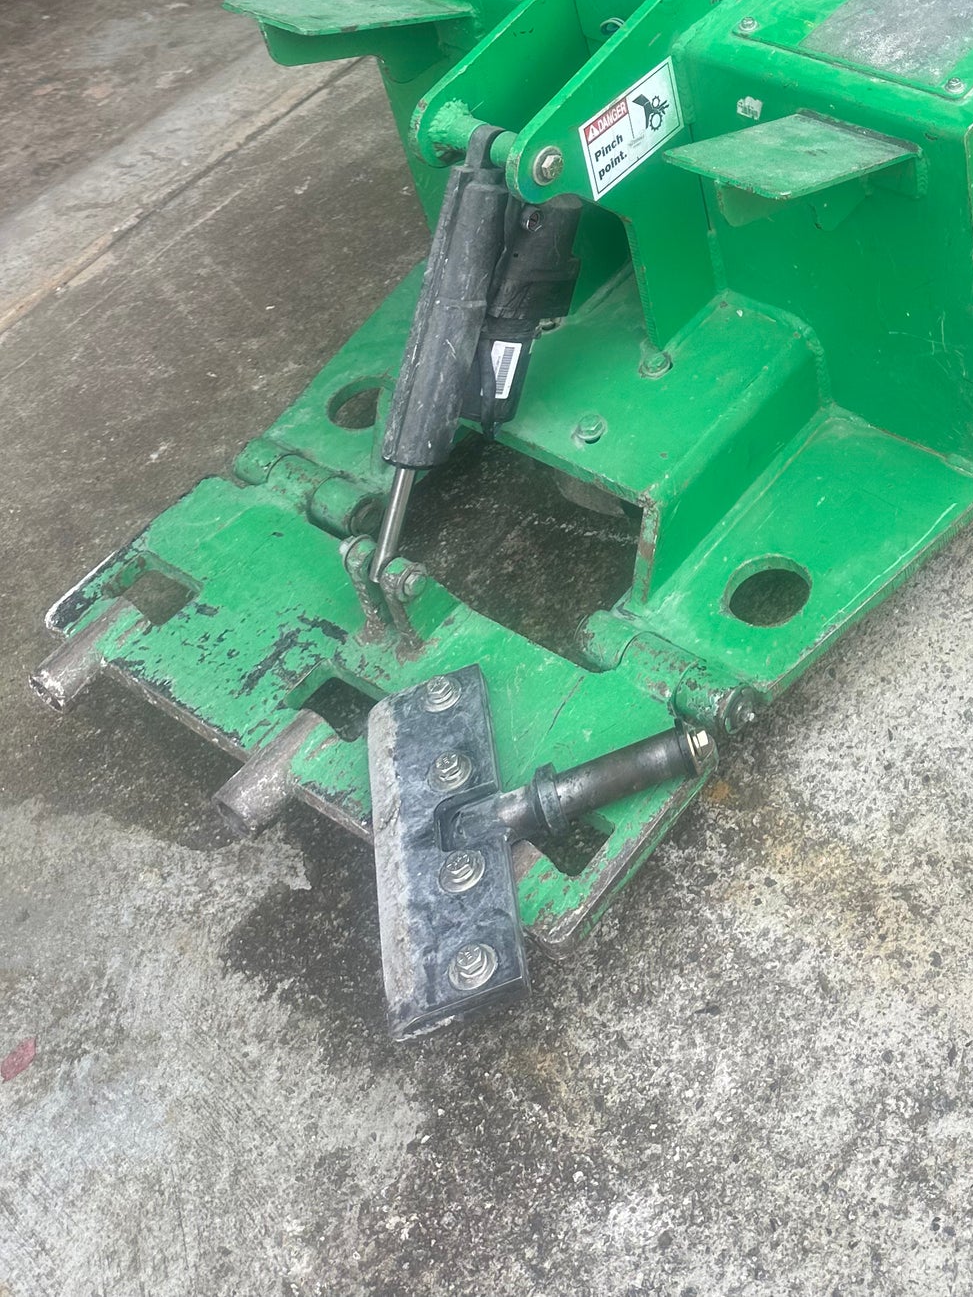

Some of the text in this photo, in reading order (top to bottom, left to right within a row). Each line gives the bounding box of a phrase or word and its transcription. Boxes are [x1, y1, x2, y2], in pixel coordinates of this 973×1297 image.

[597, 100, 628, 132] DANGER
[594, 134, 624, 162] Pinch
[598, 150, 628, 180] point.
